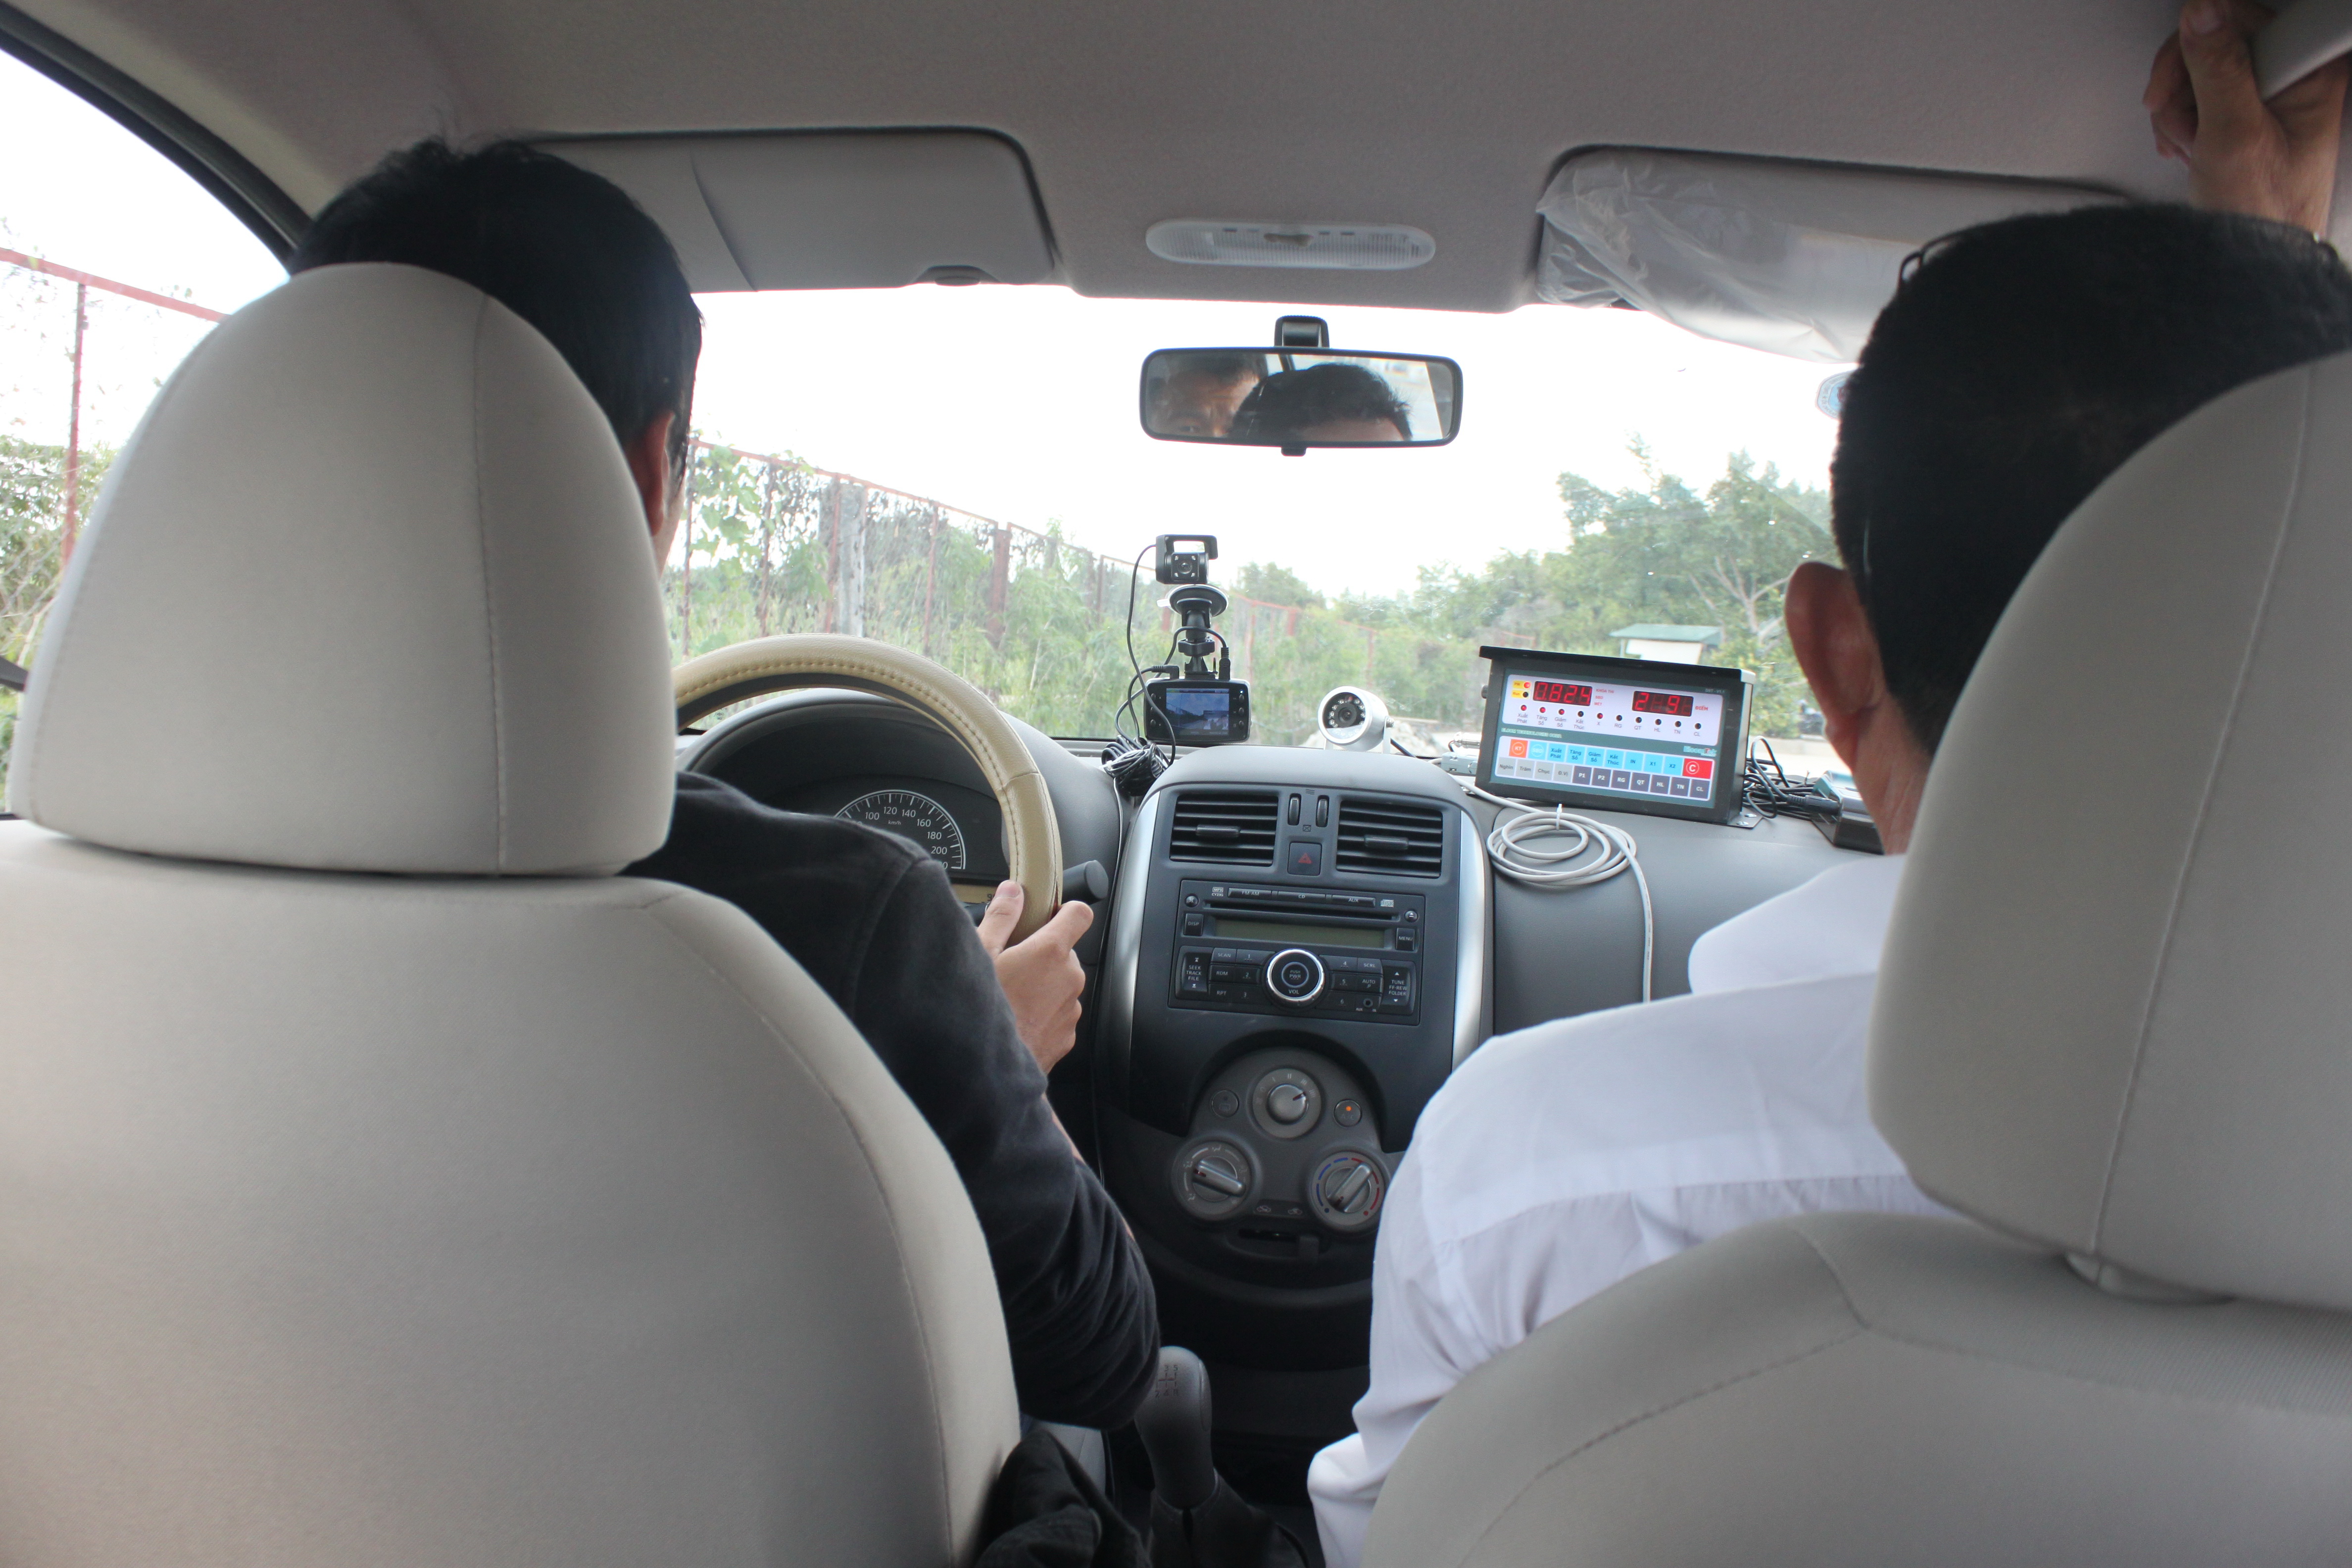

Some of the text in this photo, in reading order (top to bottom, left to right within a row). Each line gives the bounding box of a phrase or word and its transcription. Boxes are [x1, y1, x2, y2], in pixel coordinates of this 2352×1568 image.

[1534, 683, 1592, 705] 0824
[883, 806, 897, 815] 120
[902, 809, 916, 818] 140
[866, 812, 880, 821] 100
[917, 819, 931, 828] 160
[927, 831, 942, 840] 180
[931, 846, 947, 855] 200
